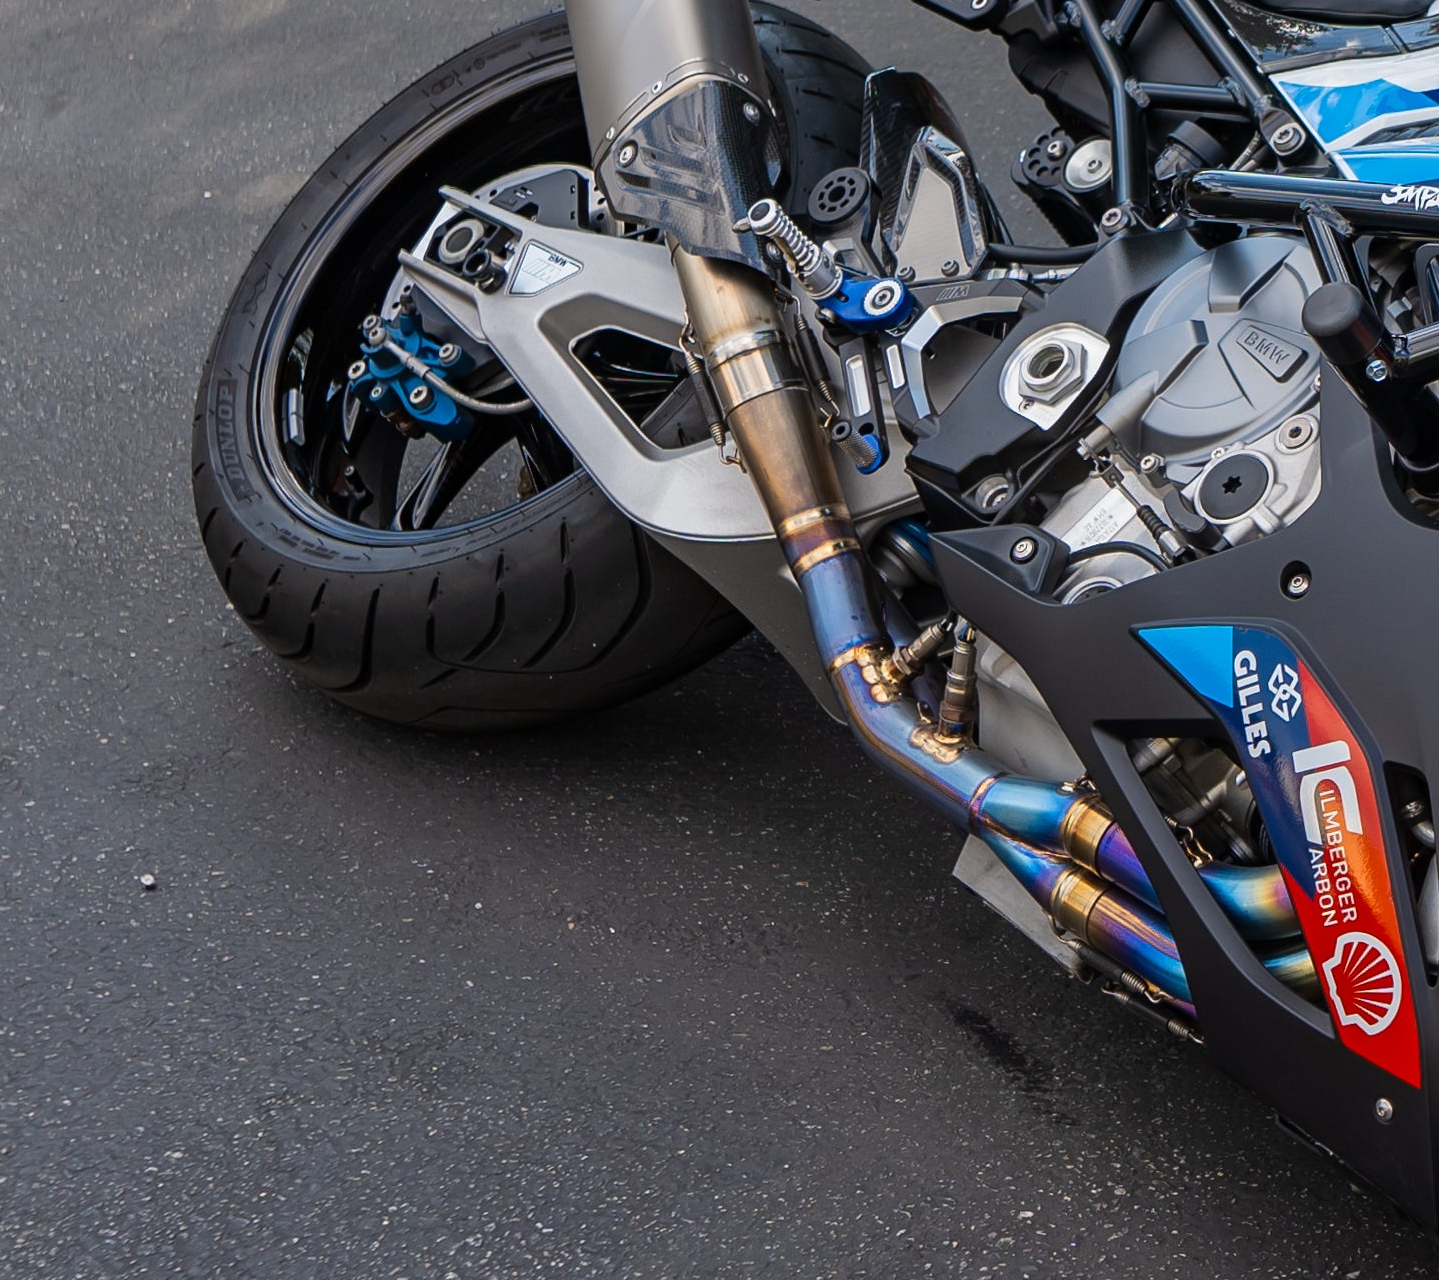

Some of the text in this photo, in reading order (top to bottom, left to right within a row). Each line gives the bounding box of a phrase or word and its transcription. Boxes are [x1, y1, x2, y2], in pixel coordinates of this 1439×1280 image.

[1243, 330, 1290, 364] BMW
[218, 385, 243, 481] DUNLOP
[1233, 649, 1271, 760] GILLES
[1318, 788, 1358, 925] ILMBERGER
